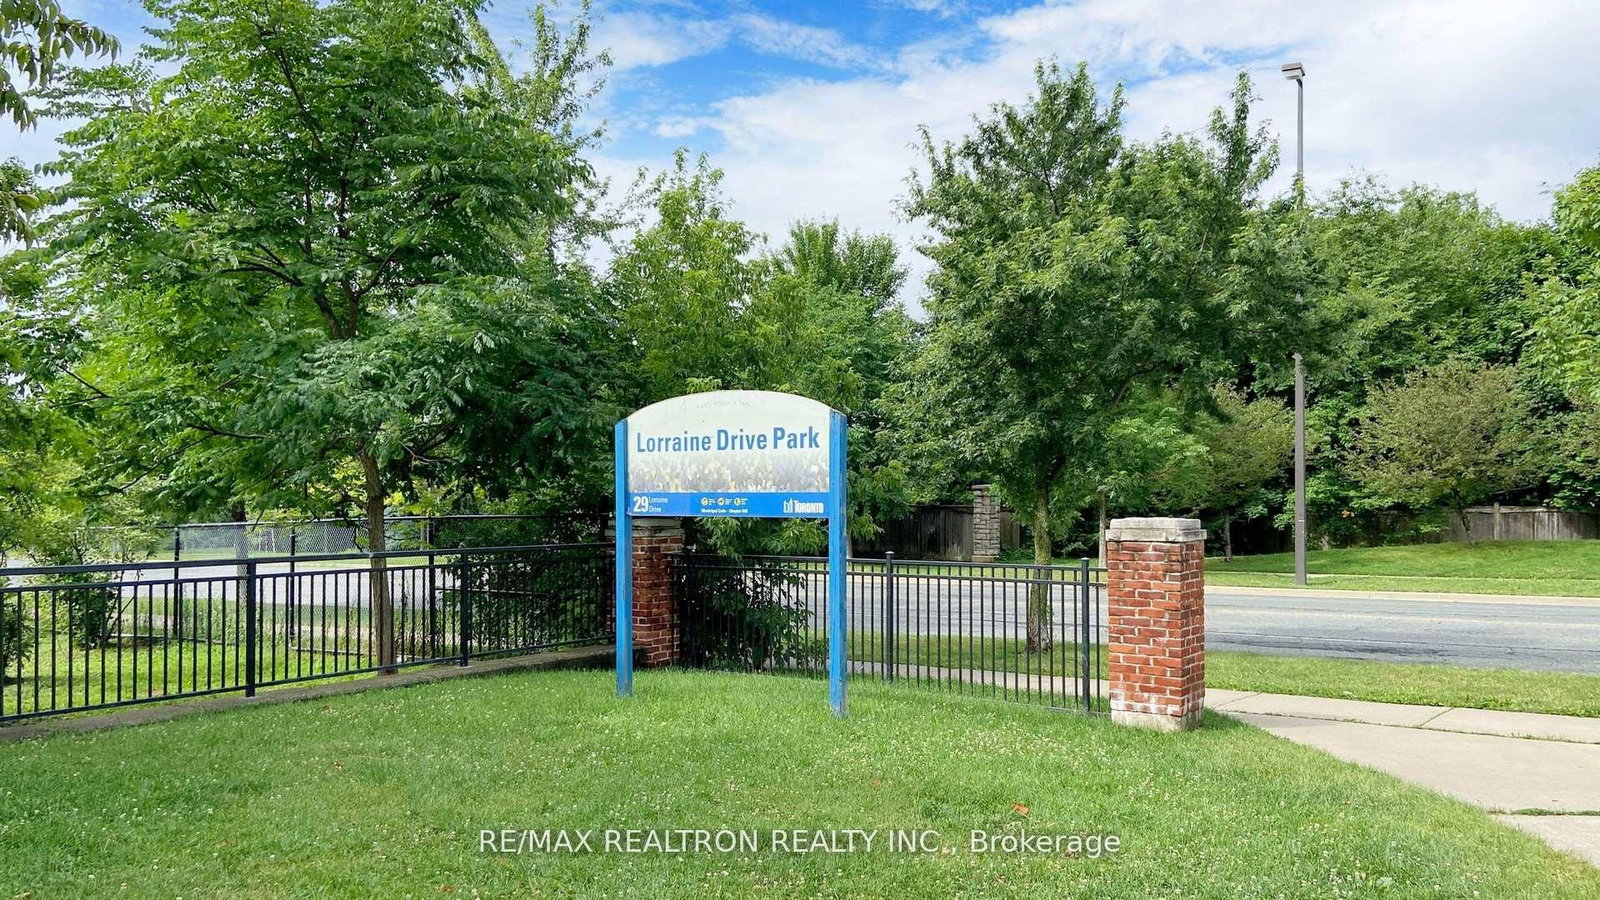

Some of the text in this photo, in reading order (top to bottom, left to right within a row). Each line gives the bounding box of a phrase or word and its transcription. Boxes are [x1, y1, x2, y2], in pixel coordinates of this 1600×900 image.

[637, 426, 820, 453] Lorraine Drive Park
[633, 495, 649, 513] 29
